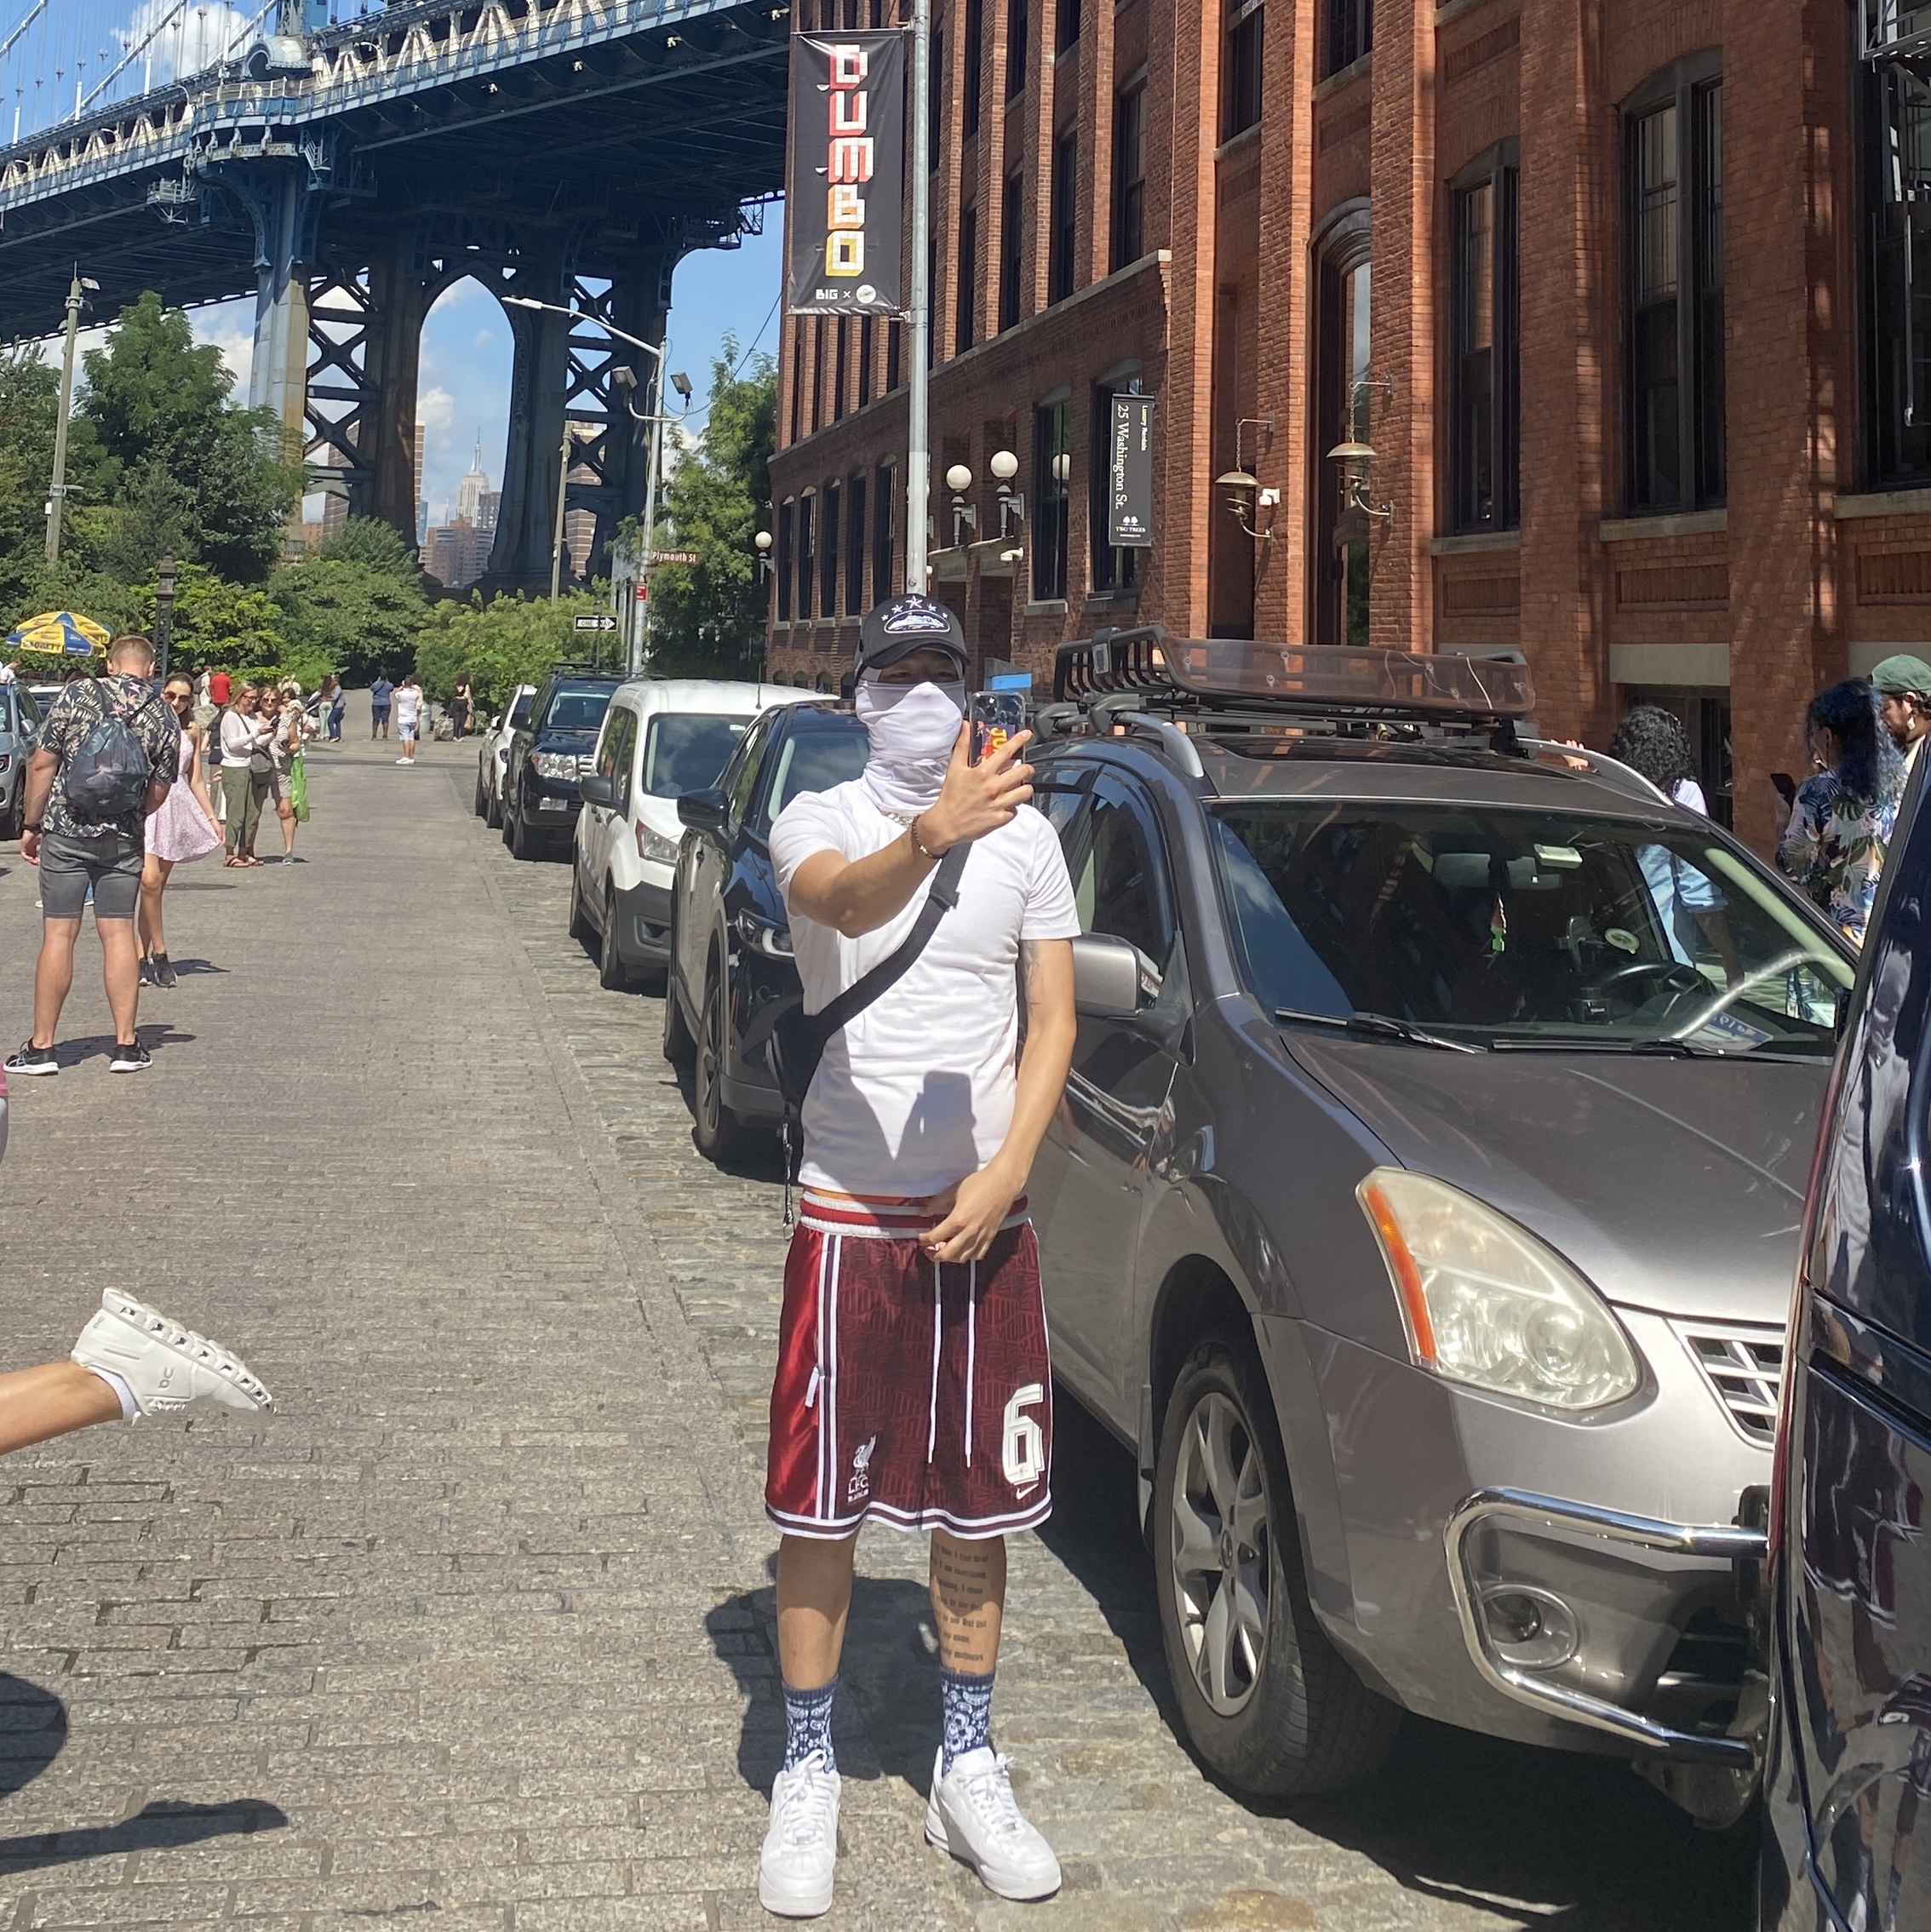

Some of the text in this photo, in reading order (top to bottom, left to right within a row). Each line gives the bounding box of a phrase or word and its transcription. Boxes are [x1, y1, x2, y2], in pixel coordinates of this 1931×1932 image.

[825, 43, 874, 277] DUMBO
[816, 289, 839, 300] BIG
[1112, 404, 1130, 509] 25 Washington St.
[652, 551, 696, 563] Plymouth St
[1002, 1383, 1046, 1485] 6
